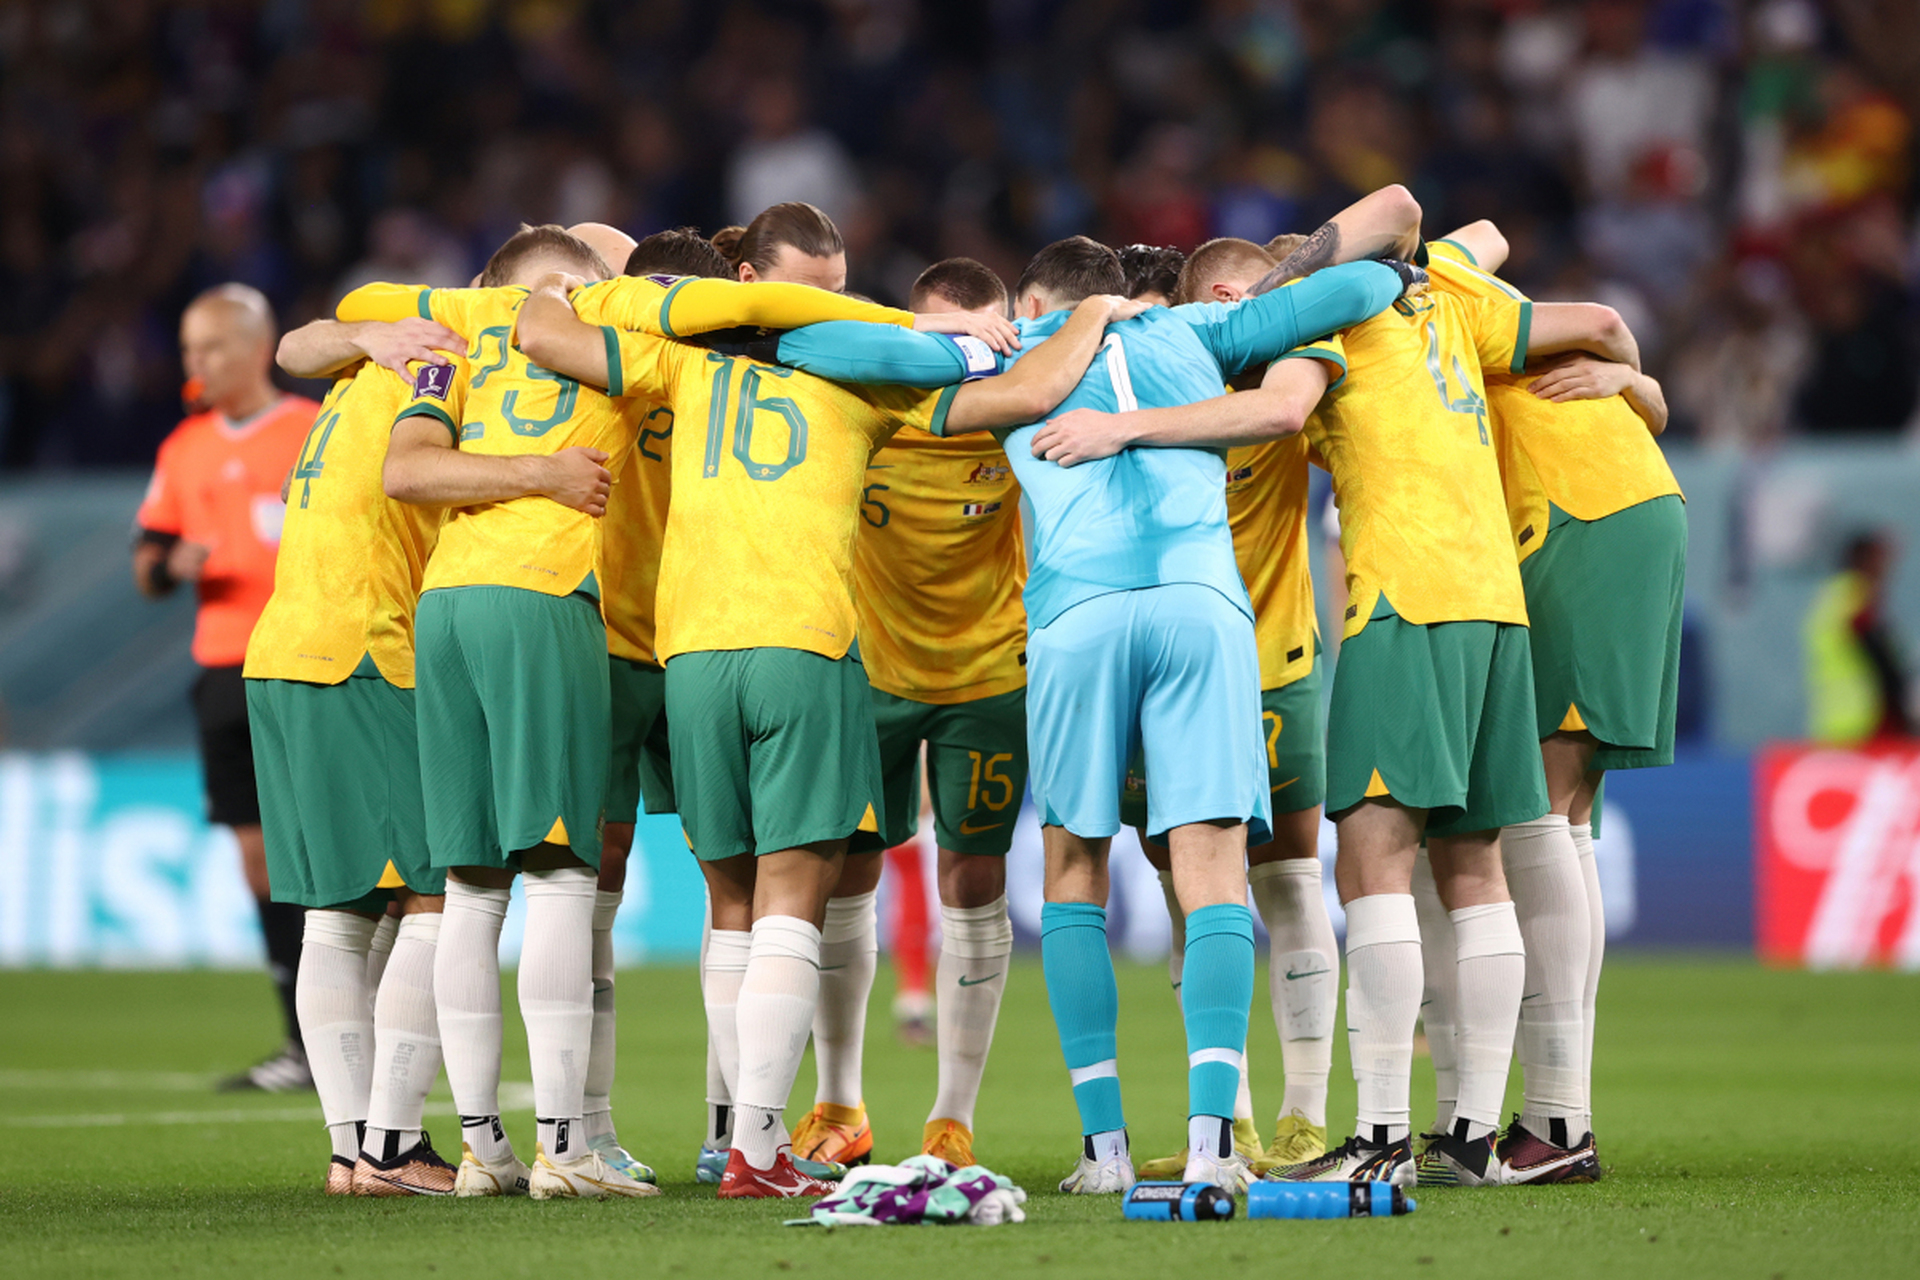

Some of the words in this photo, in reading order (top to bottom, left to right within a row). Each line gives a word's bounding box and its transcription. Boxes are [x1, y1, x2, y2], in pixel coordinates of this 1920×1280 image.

[1096, 331, 1139, 413] 1
[1426, 321, 1489, 447] 4
[702, 351, 808, 482] 16
[967, 750, 1013, 811] 15
[1262, 710, 1284, 769] 7
